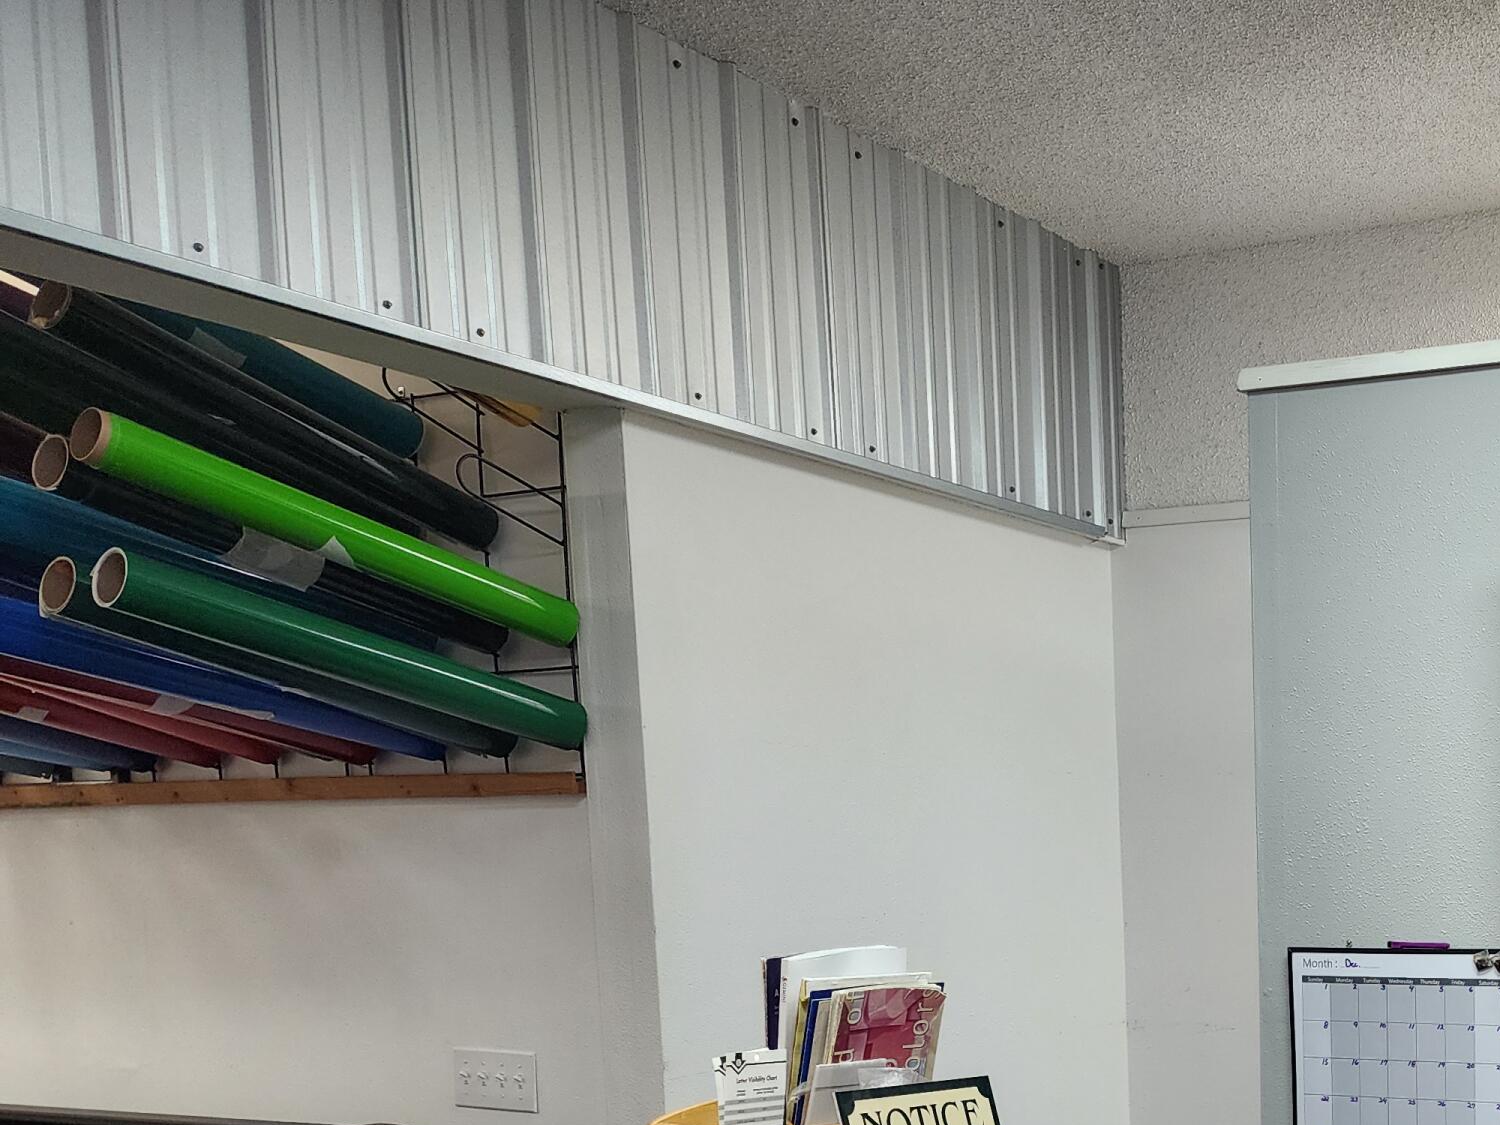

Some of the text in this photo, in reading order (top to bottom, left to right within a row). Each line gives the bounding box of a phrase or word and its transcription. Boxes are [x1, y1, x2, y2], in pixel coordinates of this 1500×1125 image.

[1324, 1021, 1329, 1029] 8
[902, 988, 941, 1071] olors
[1322, 1058, 1329, 1066] 15
[1351, 1058, 1359, 1066] 16
[1380, 1058, 1388, 1066] 17
[748, 1076, 766, 1084] Visibility
[1467, 1102, 1476, 1110] 27
